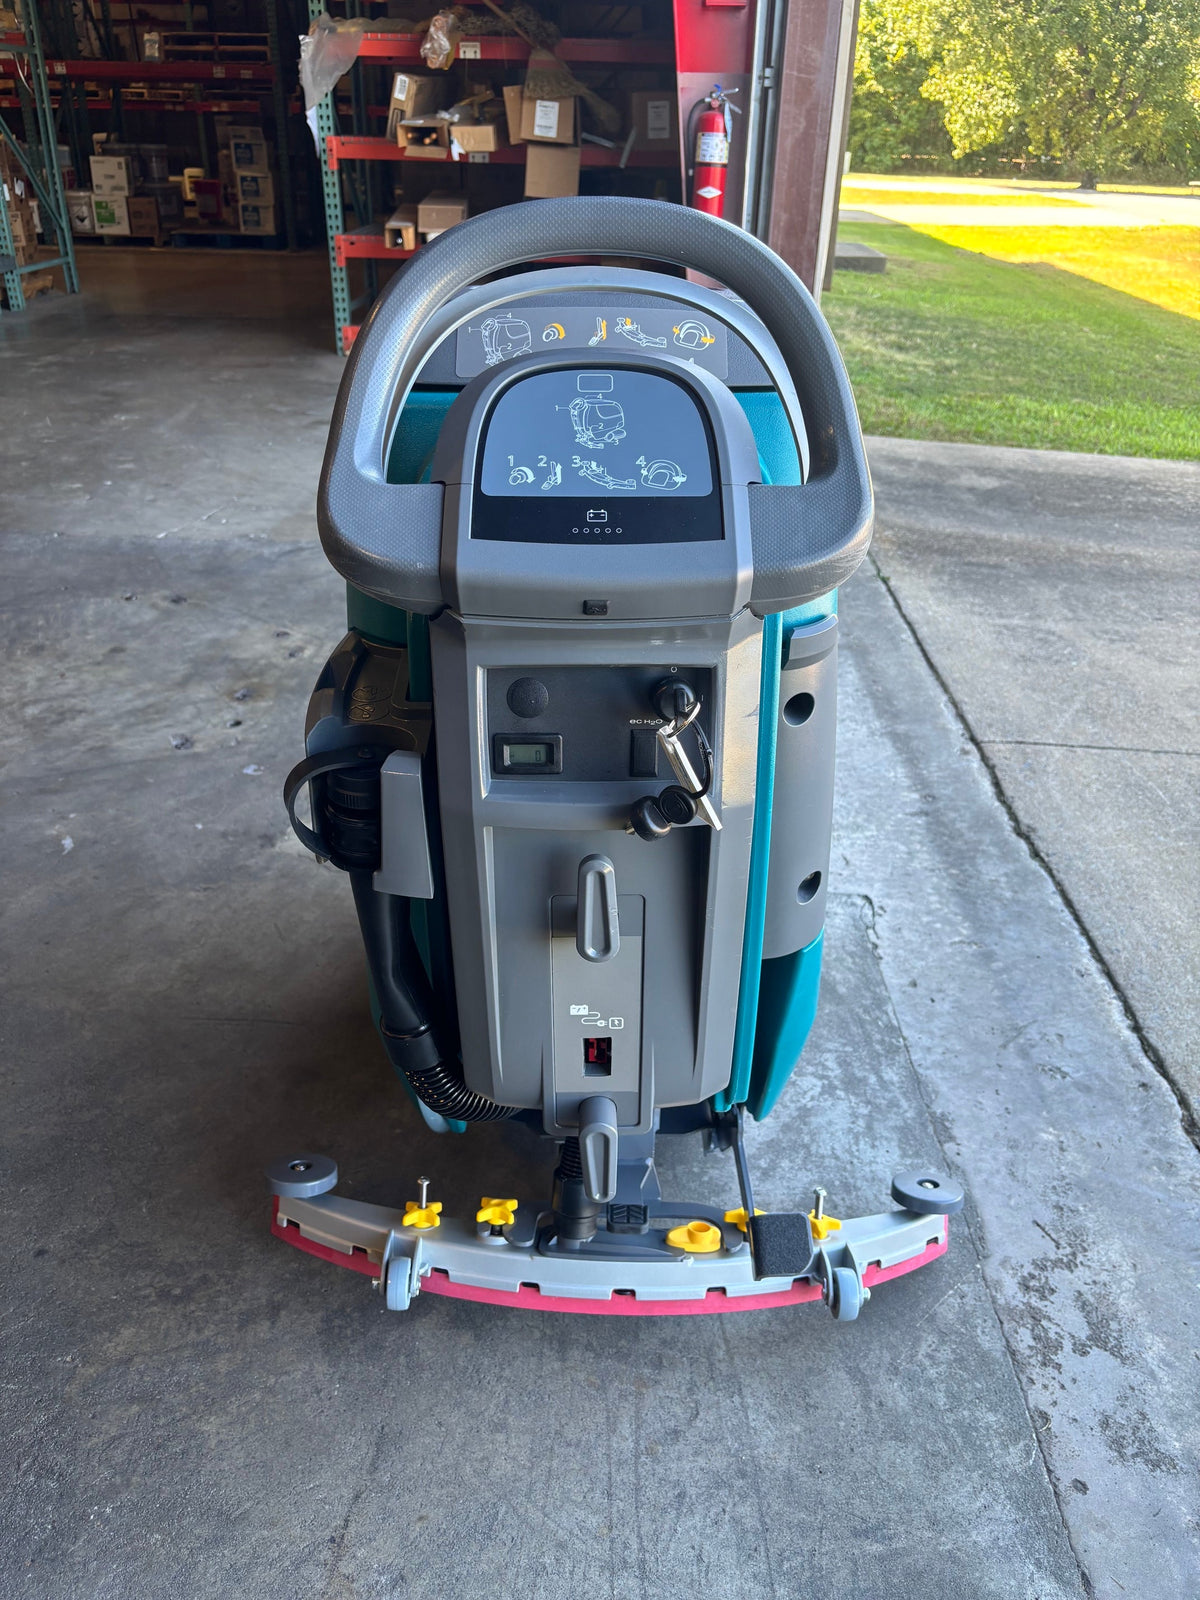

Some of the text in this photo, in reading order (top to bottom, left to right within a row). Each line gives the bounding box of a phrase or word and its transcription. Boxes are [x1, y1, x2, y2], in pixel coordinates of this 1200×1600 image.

[507, 454, 647, 467] 1 2 3 4
